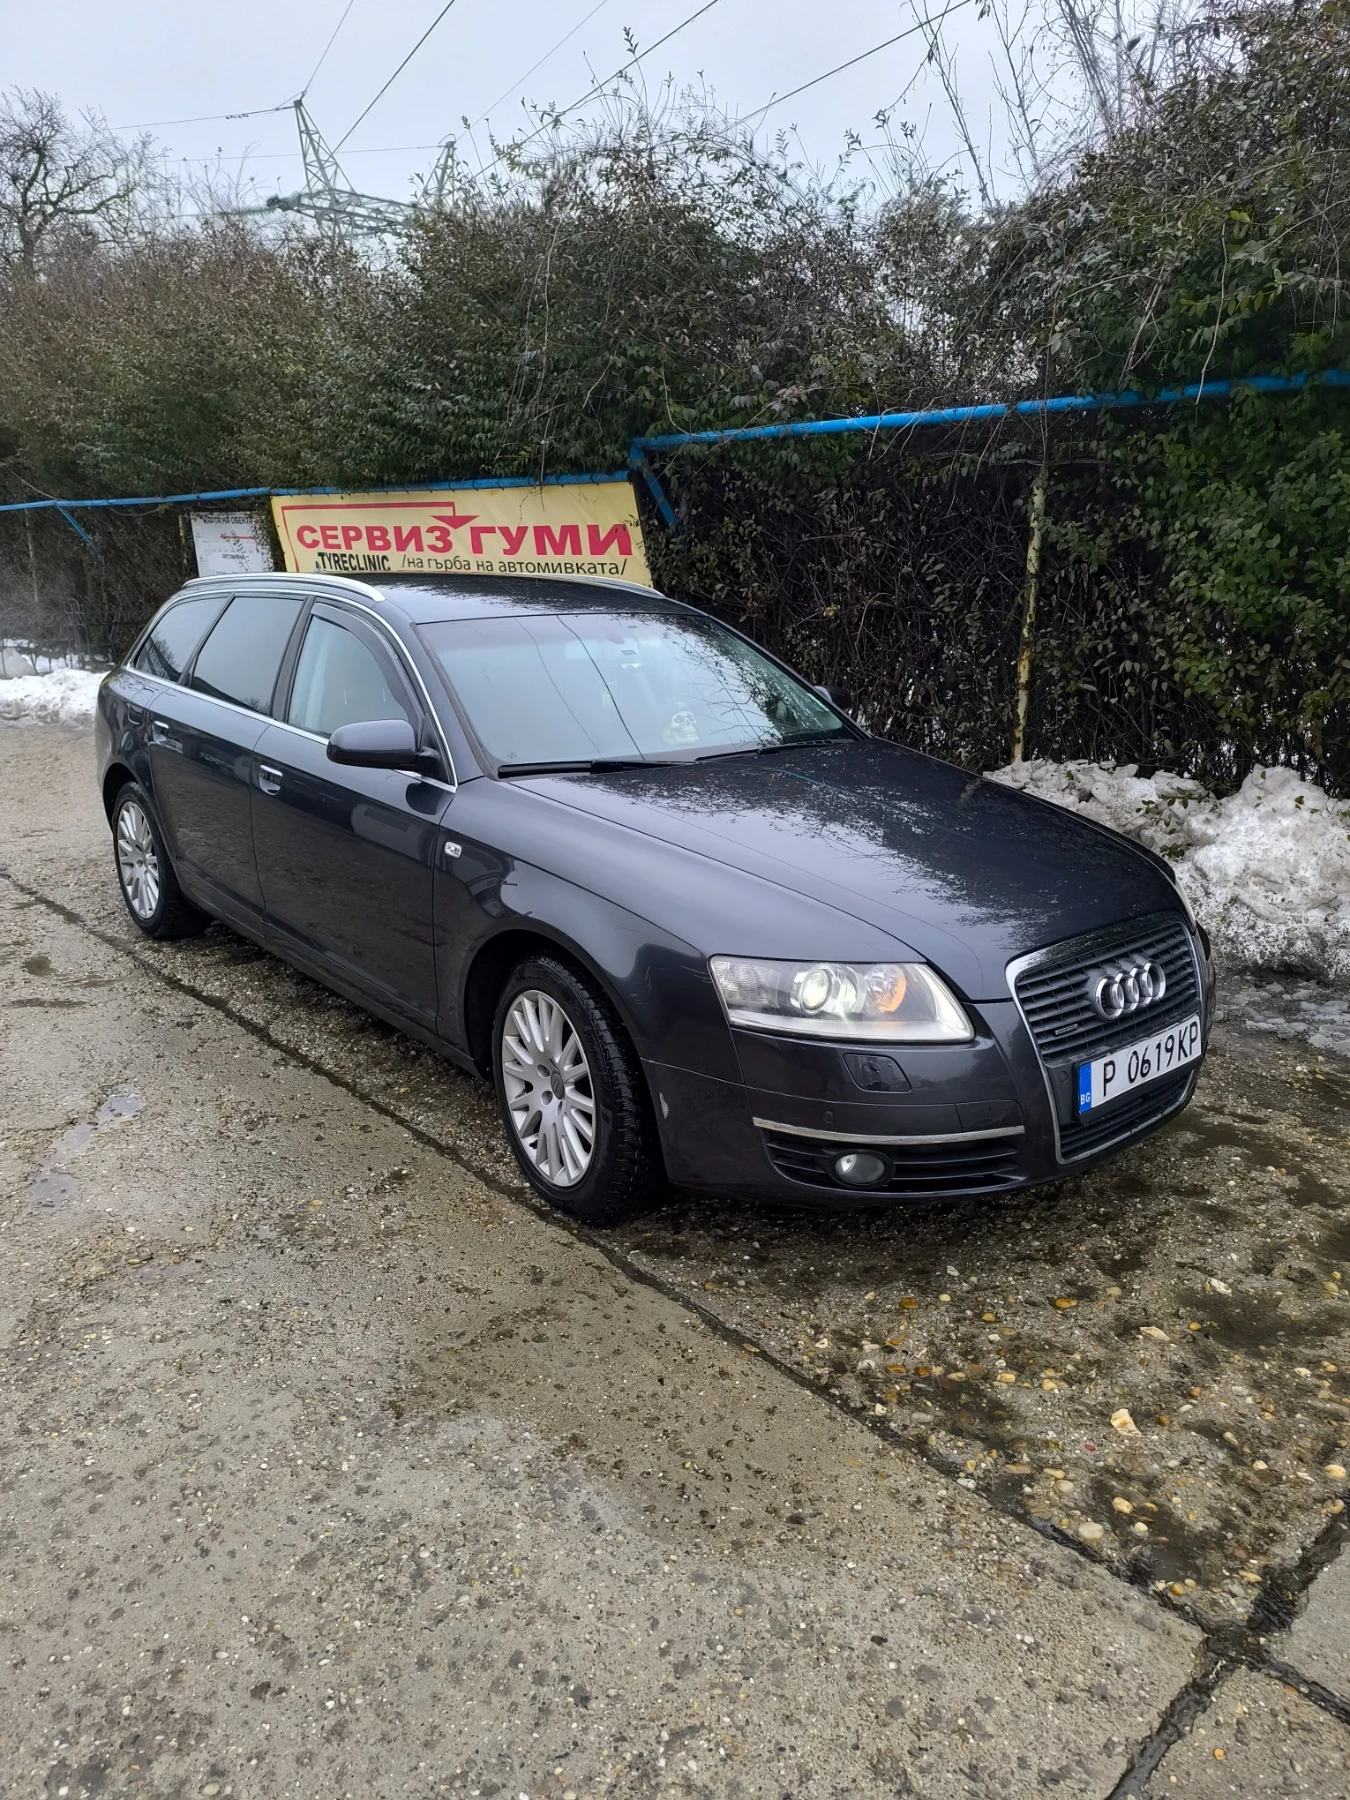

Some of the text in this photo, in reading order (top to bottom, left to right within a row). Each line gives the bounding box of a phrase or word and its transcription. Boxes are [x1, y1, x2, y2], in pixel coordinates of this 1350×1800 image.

[296, 523, 633, 556] СЕРВИЗ ГУМИ
[317, 551, 391, 571] TYRECLINIC
[401, 554, 628, 575] /на гърба на автомивката/
[1103, 1060, 1116, 1097] P
[1080, 1092, 1091, 1105] BG
